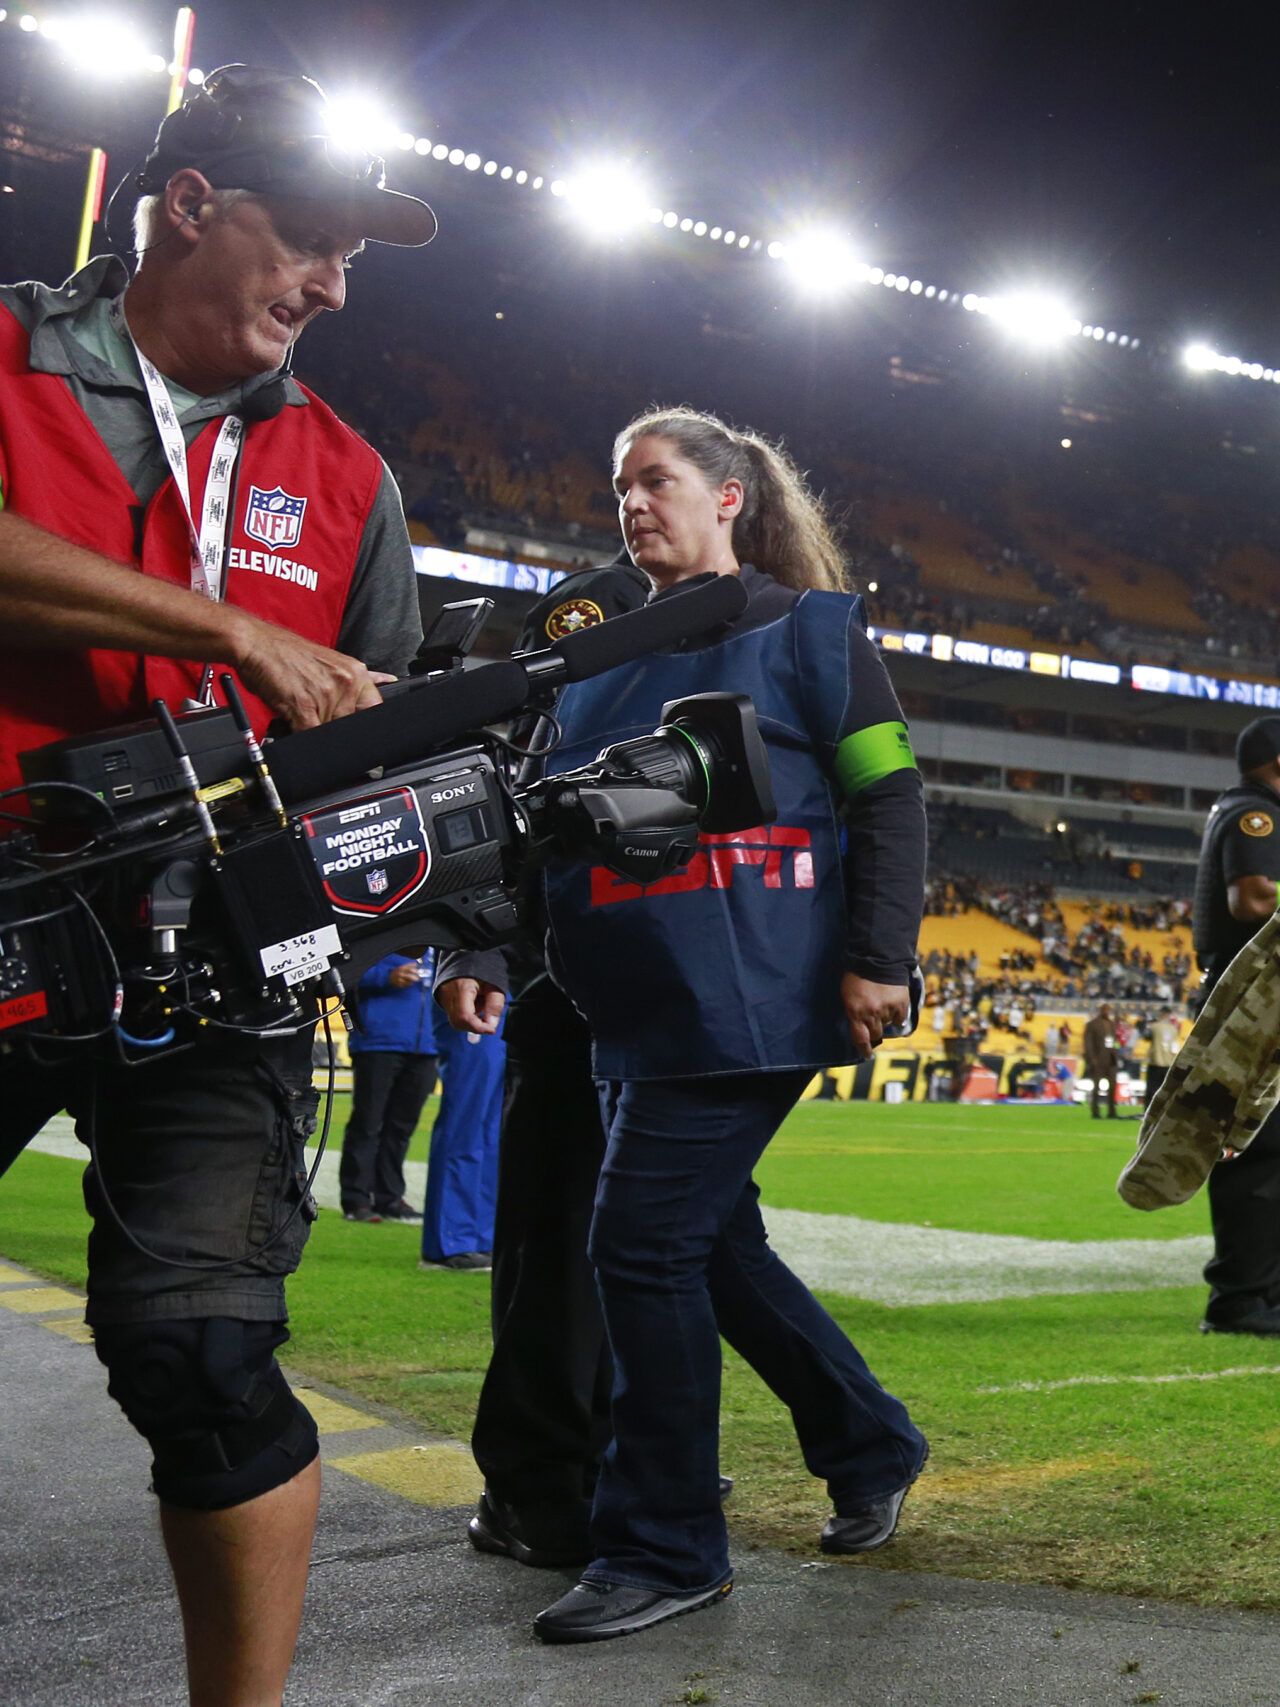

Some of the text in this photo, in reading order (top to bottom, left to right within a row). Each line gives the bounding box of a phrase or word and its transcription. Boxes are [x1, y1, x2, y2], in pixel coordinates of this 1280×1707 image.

[251, 510, 295, 541] NFL
[228, 547, 319, 592] ELEVISION
[431, 783, 476, 803] SONY
[338, 802, 381, 825] ESPN
[325, 817, 403, 849] MONDAY
[339, 832, 396, 858] NIGHT
[322, 839, 419, 876] FOOTBALL
[624, 846, 659, 857] Canon
[290, 962, 323, 981] VB 200
